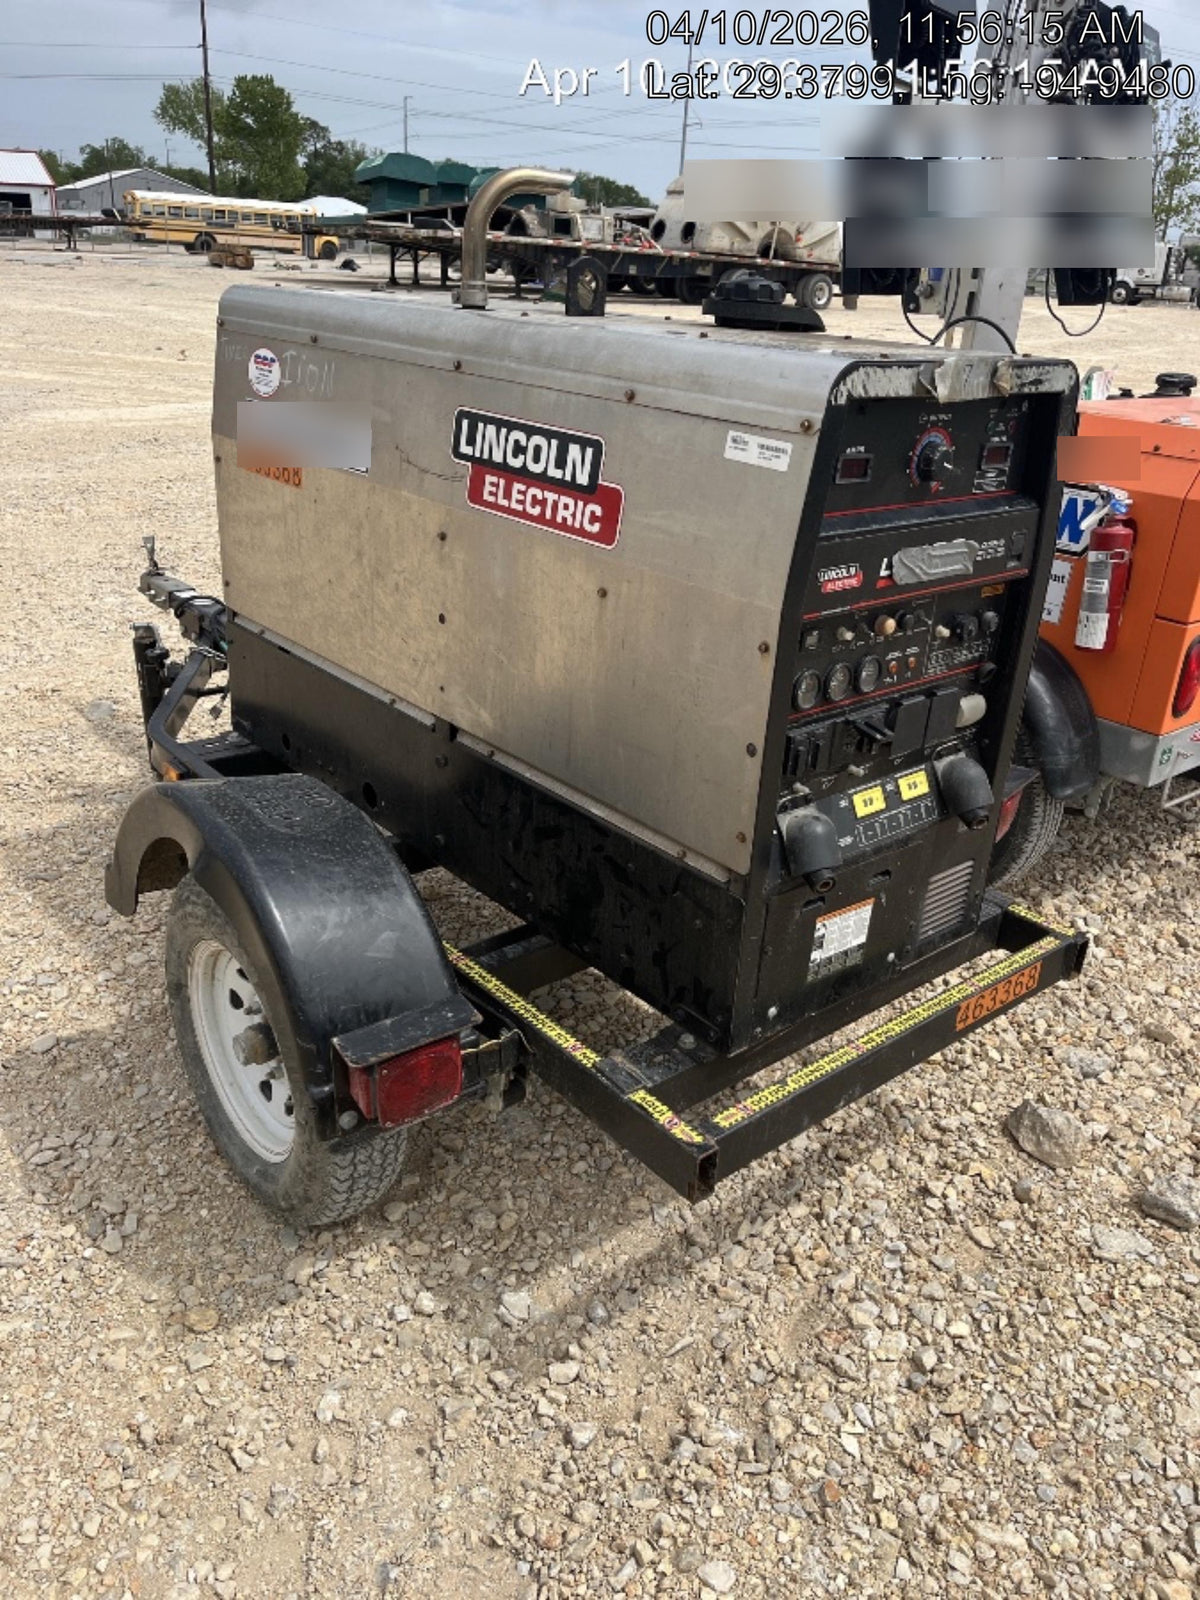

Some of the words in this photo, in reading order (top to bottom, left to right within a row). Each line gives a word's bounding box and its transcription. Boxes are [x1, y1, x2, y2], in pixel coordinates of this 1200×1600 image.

[459, 418, 593, 487] LINCOLN
[482, 474, 603, 534] ELECTRIC
[957, 964, 1039, 1027] 463368
